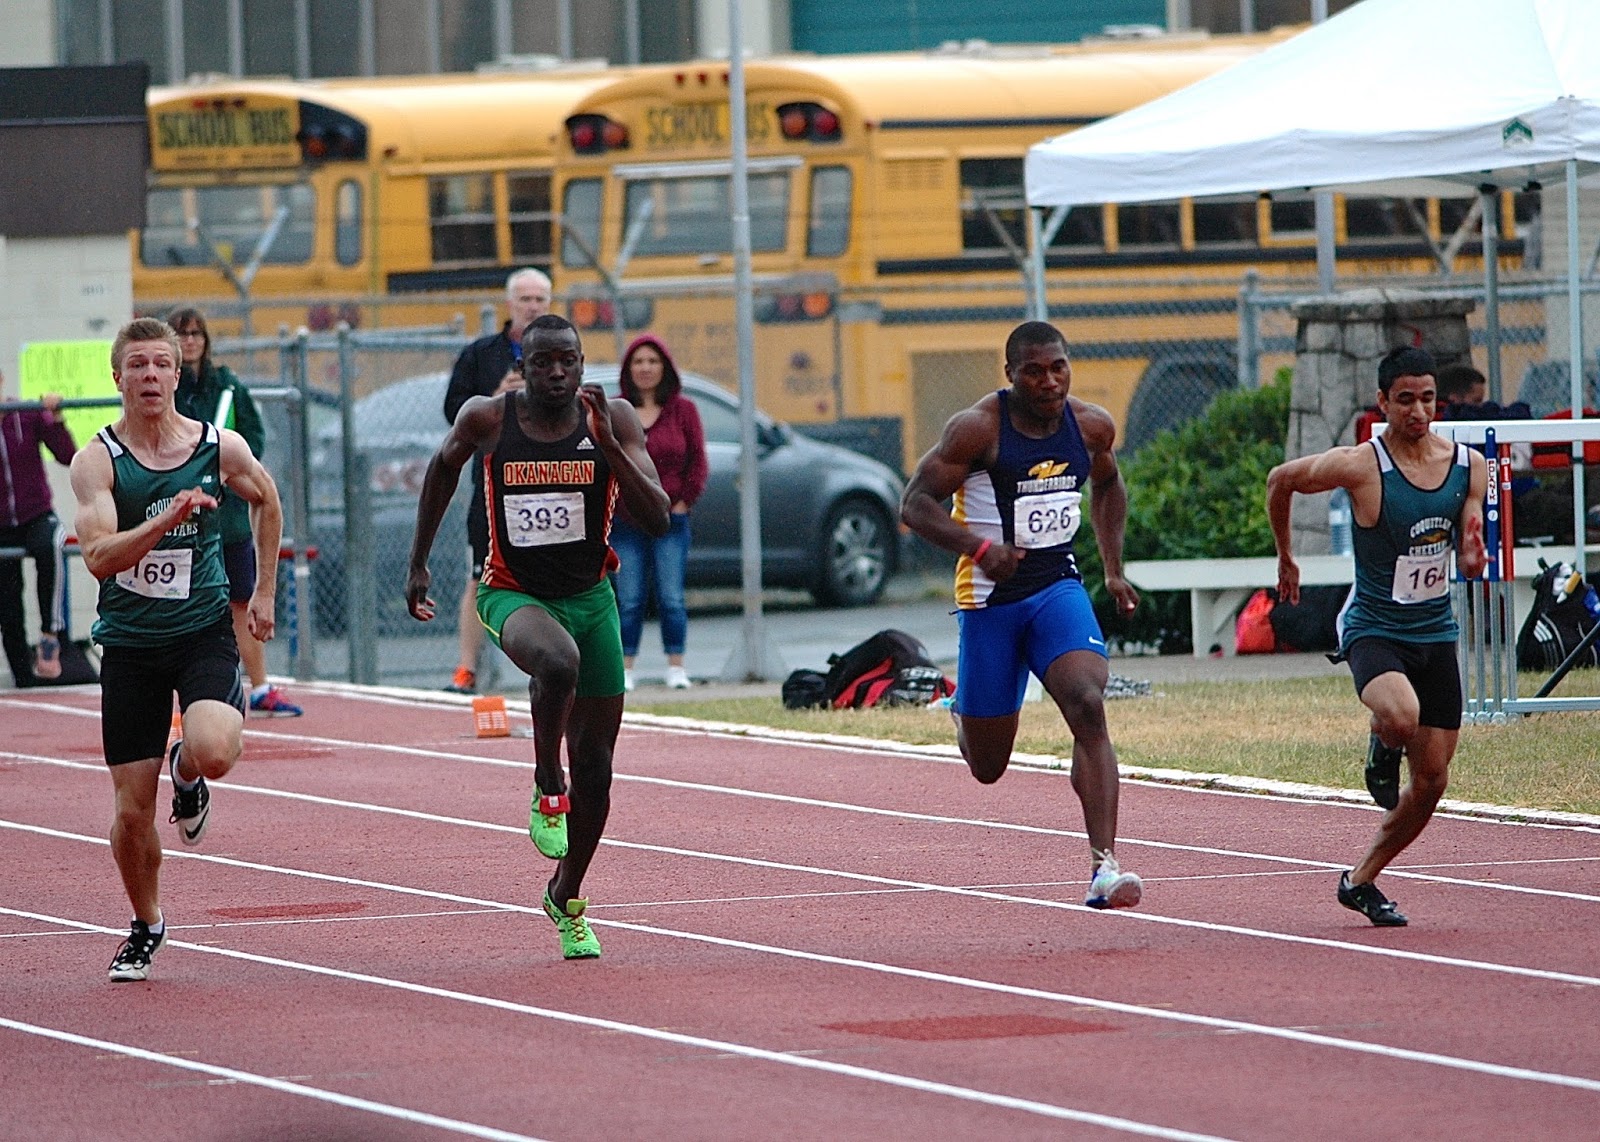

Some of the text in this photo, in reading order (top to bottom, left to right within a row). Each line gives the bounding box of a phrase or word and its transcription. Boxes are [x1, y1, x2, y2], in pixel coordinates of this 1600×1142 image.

[158, 107, 290, 148] SCHOOL BUS
[646, 104, 722, 143] SCHOOL
[503, 461, 595, 486] OKANAGAN
[517, 506, 571, 533] 393
[1028, 506, 1071, 534] 626
[1409, 562, 1446, 590] 164
